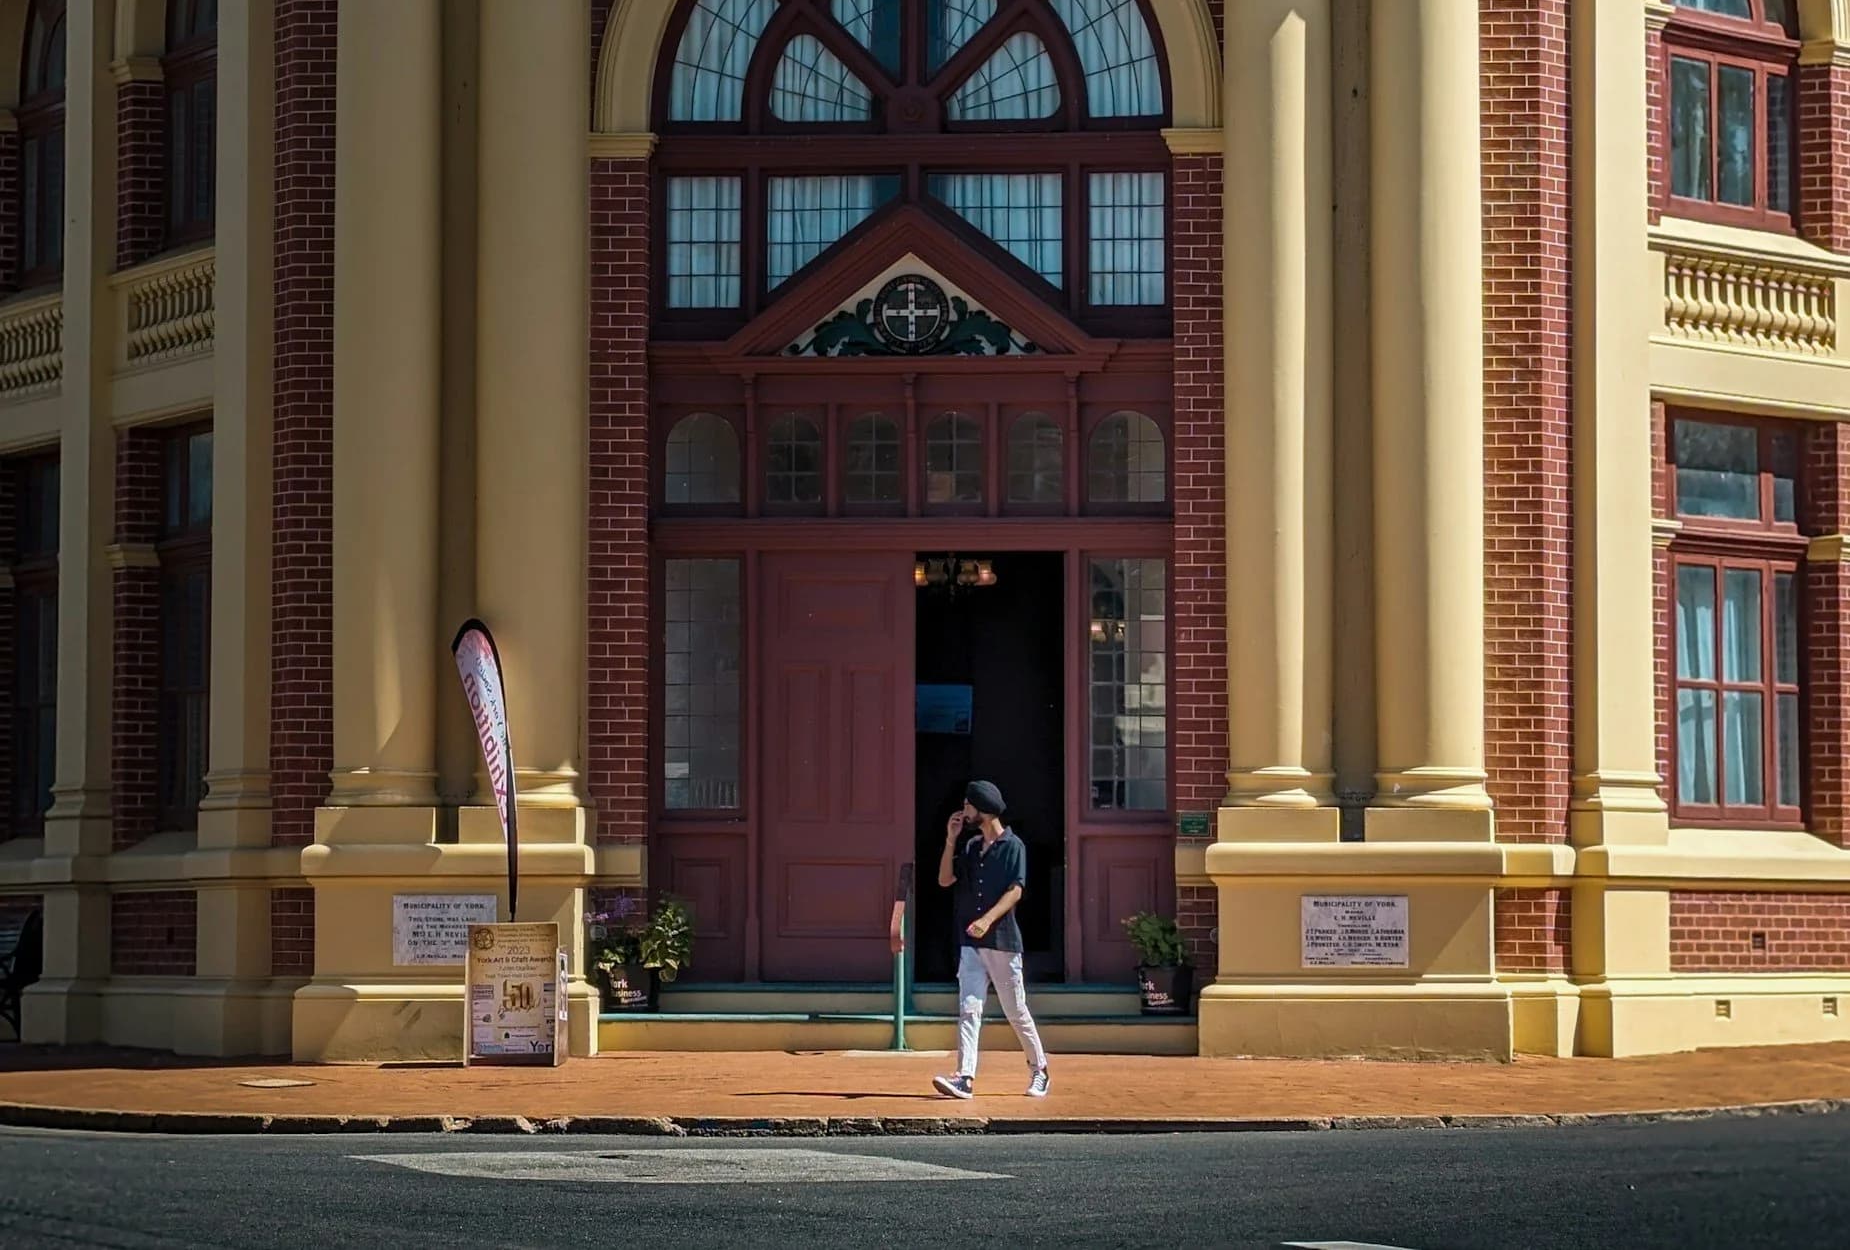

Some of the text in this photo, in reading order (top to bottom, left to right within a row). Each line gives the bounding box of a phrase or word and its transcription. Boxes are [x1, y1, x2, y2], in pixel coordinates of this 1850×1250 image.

[453, 902, 462, 910] OF
[507, 945, 531, 955] 2023
[477, 956, 492, 964] York
[492, 956, 504, 964] Art
[511, 955, 529, 964] Craft
[503, 979, 534, 1010] 50
